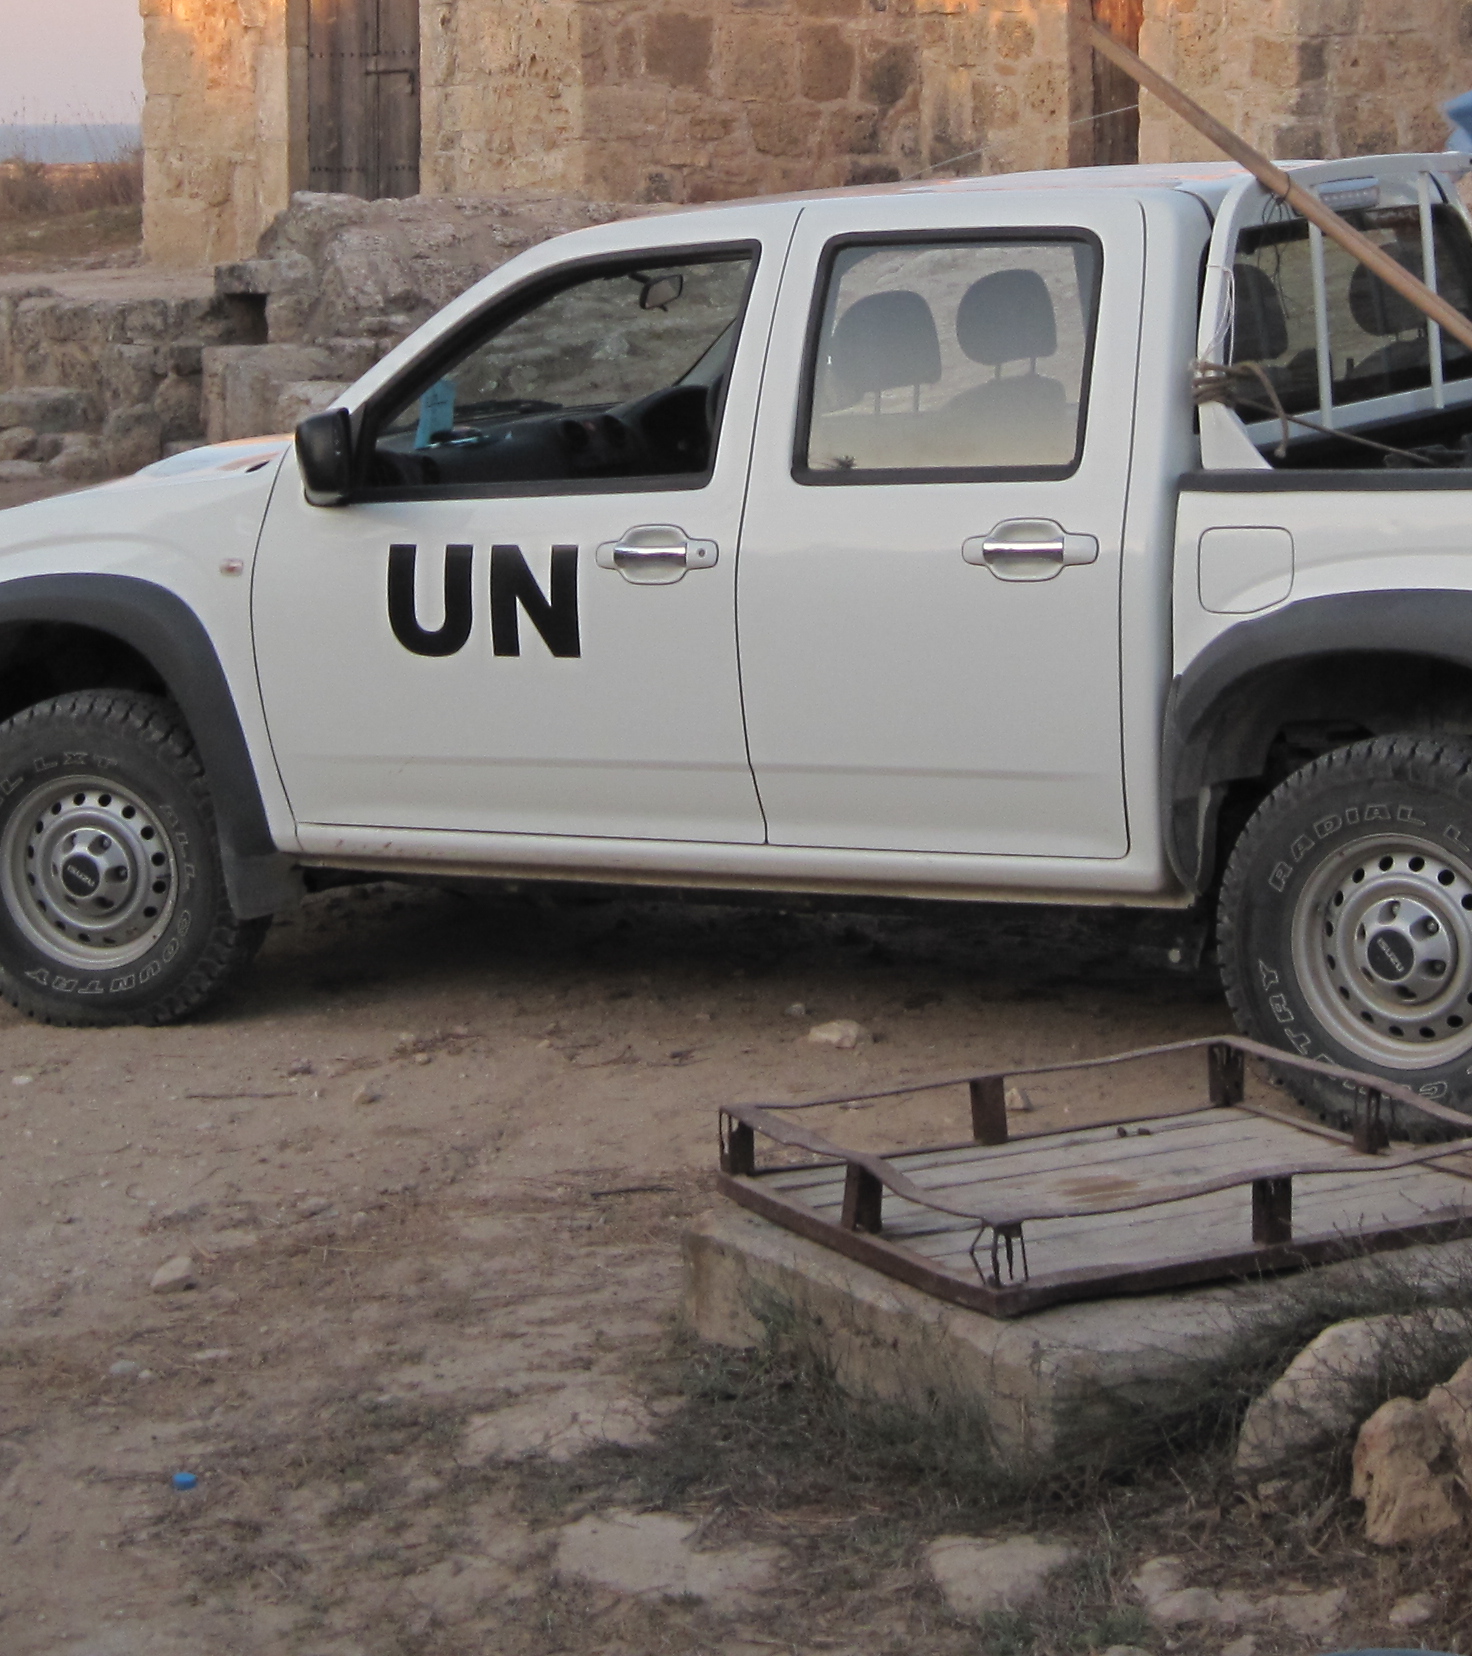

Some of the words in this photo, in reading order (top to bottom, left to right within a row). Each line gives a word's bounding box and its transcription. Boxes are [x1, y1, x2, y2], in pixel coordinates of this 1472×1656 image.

[388, 544, 581, 658] UN
[33, 752, 117, 772] LXT
[1269, 804, 1426, 892] RADIAL
[25, 909, 192, 994] COUNTRY
